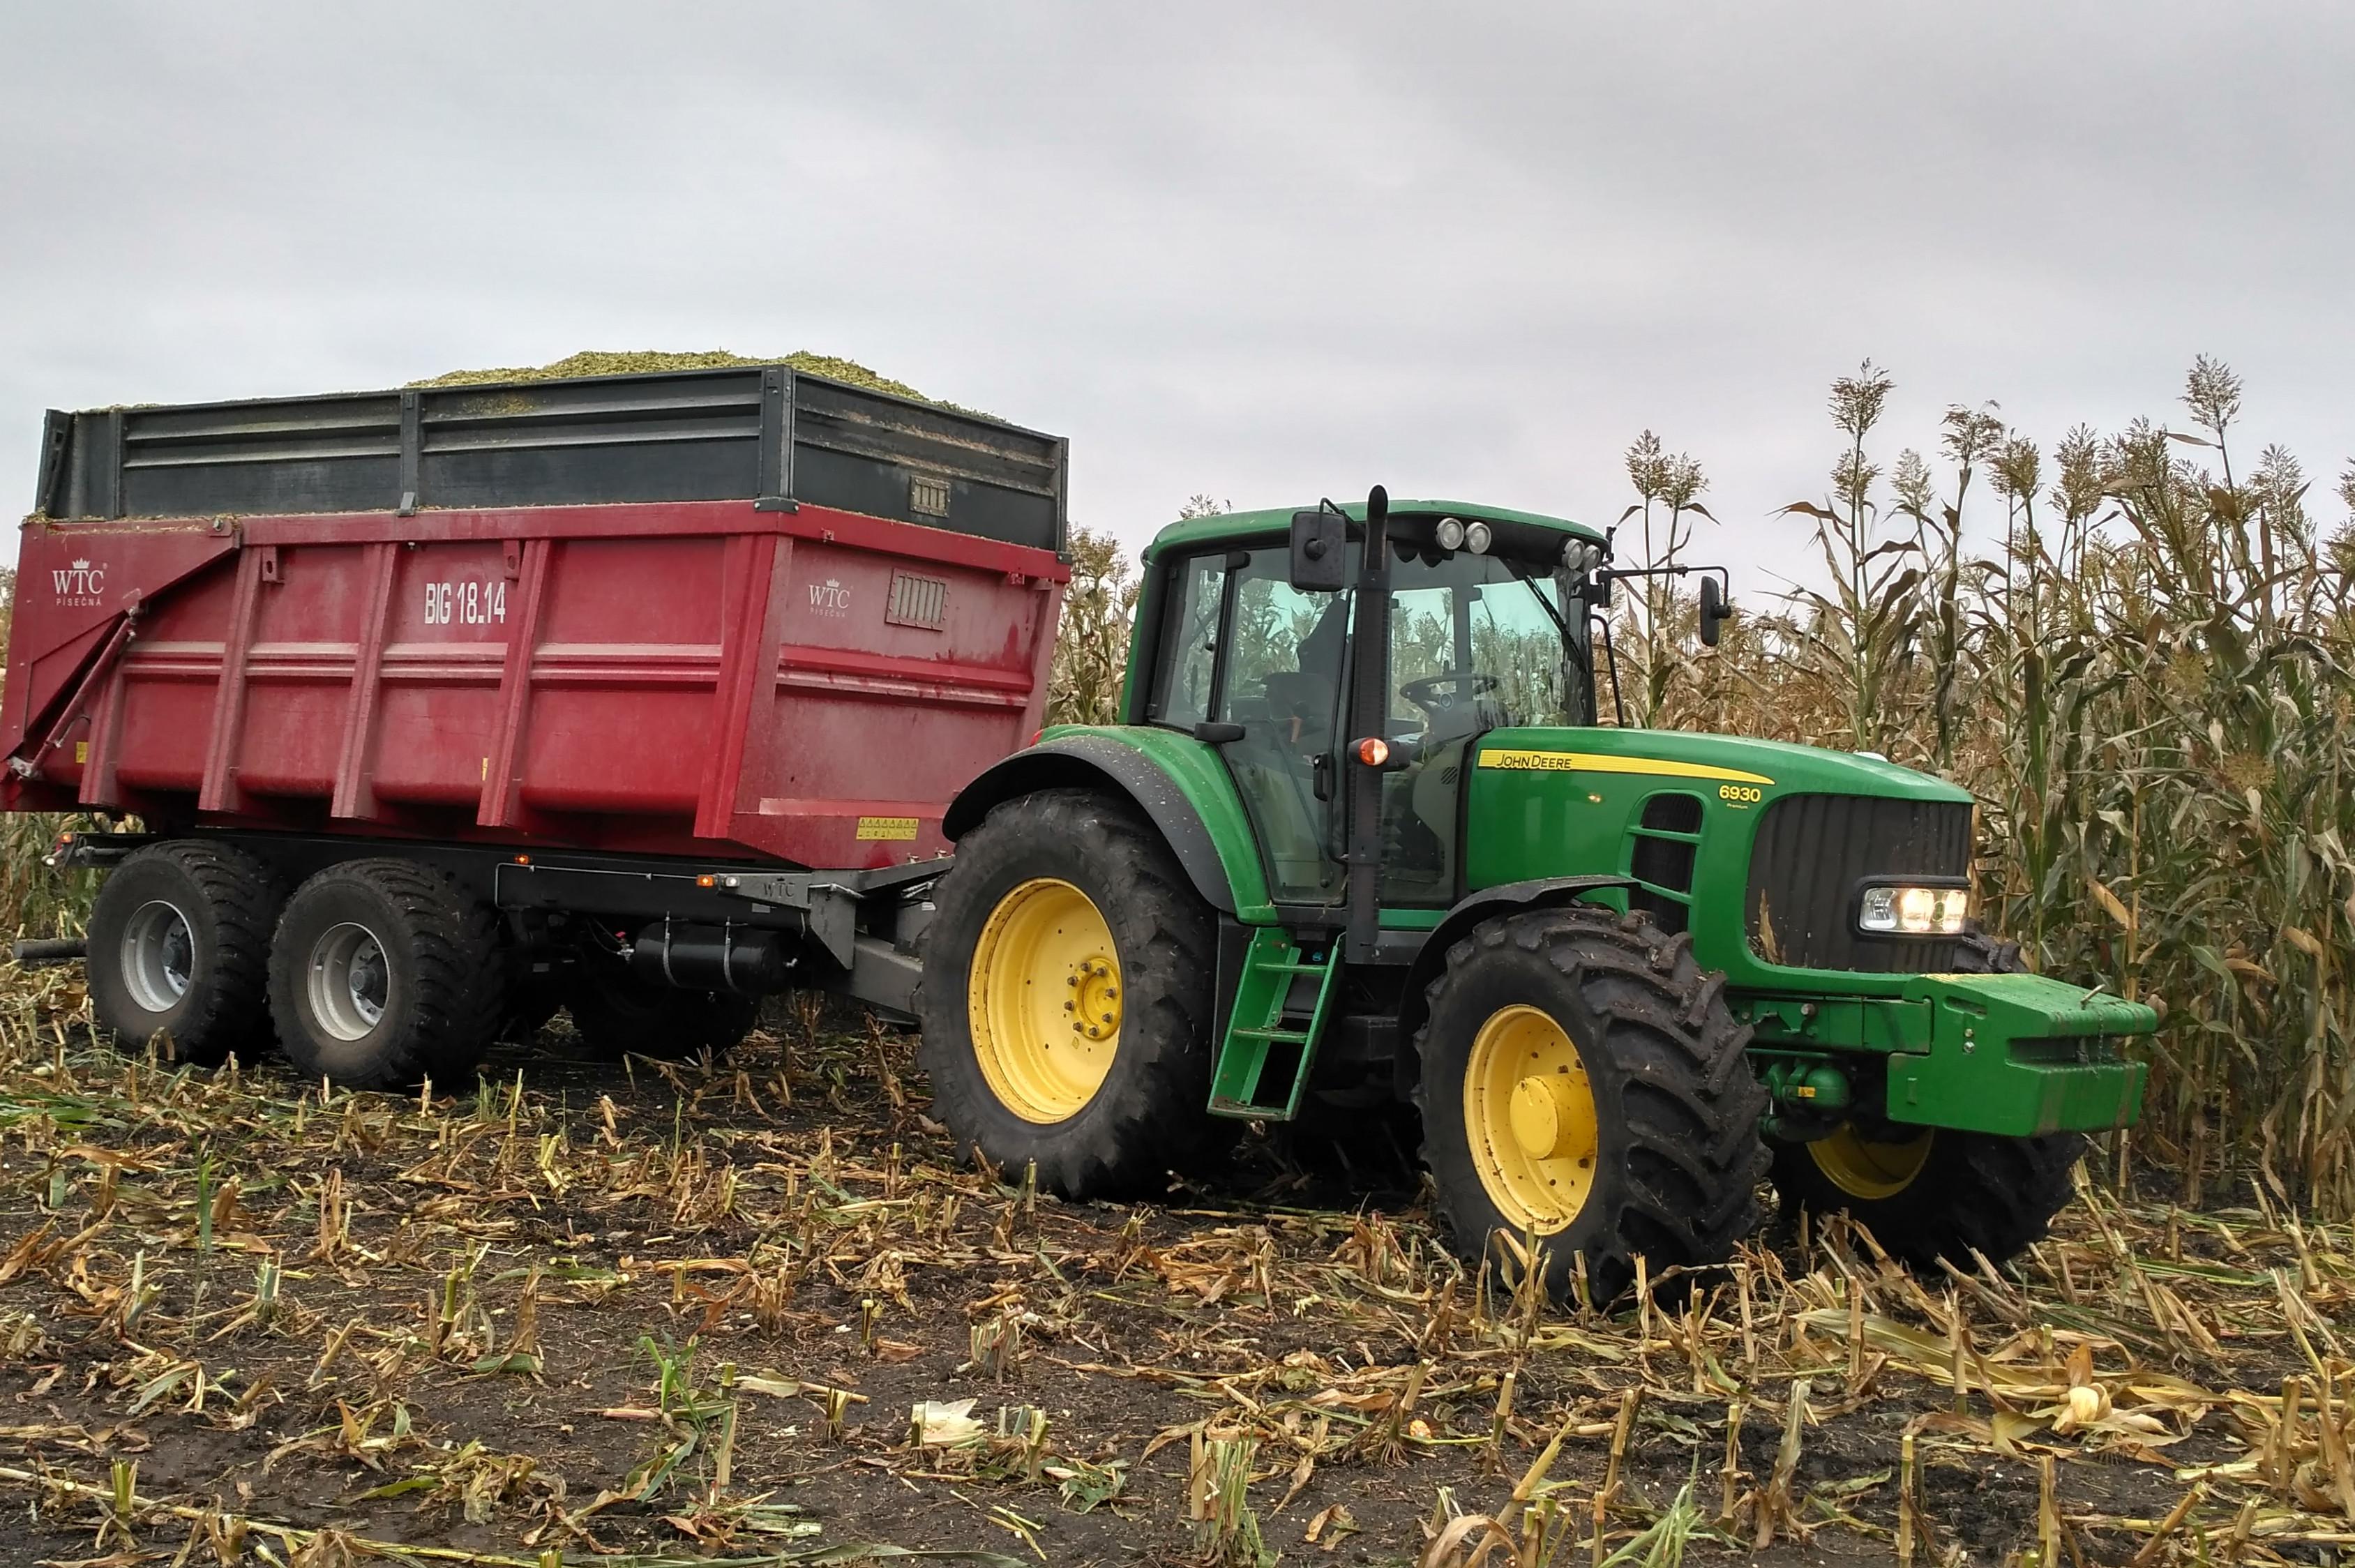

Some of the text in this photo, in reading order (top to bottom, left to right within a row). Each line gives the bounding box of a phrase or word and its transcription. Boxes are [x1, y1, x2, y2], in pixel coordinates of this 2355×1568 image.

[52, 569, 104, 595] WTC
[424, 582, 506, 624] BIG 18.14
[808, 585, 850, 609] WTC
[1496, 753, 1572, 769] JOHN DEERE
[1719, 785, 1761, 802] 6930
[763, 882, 795, 897] WTC
